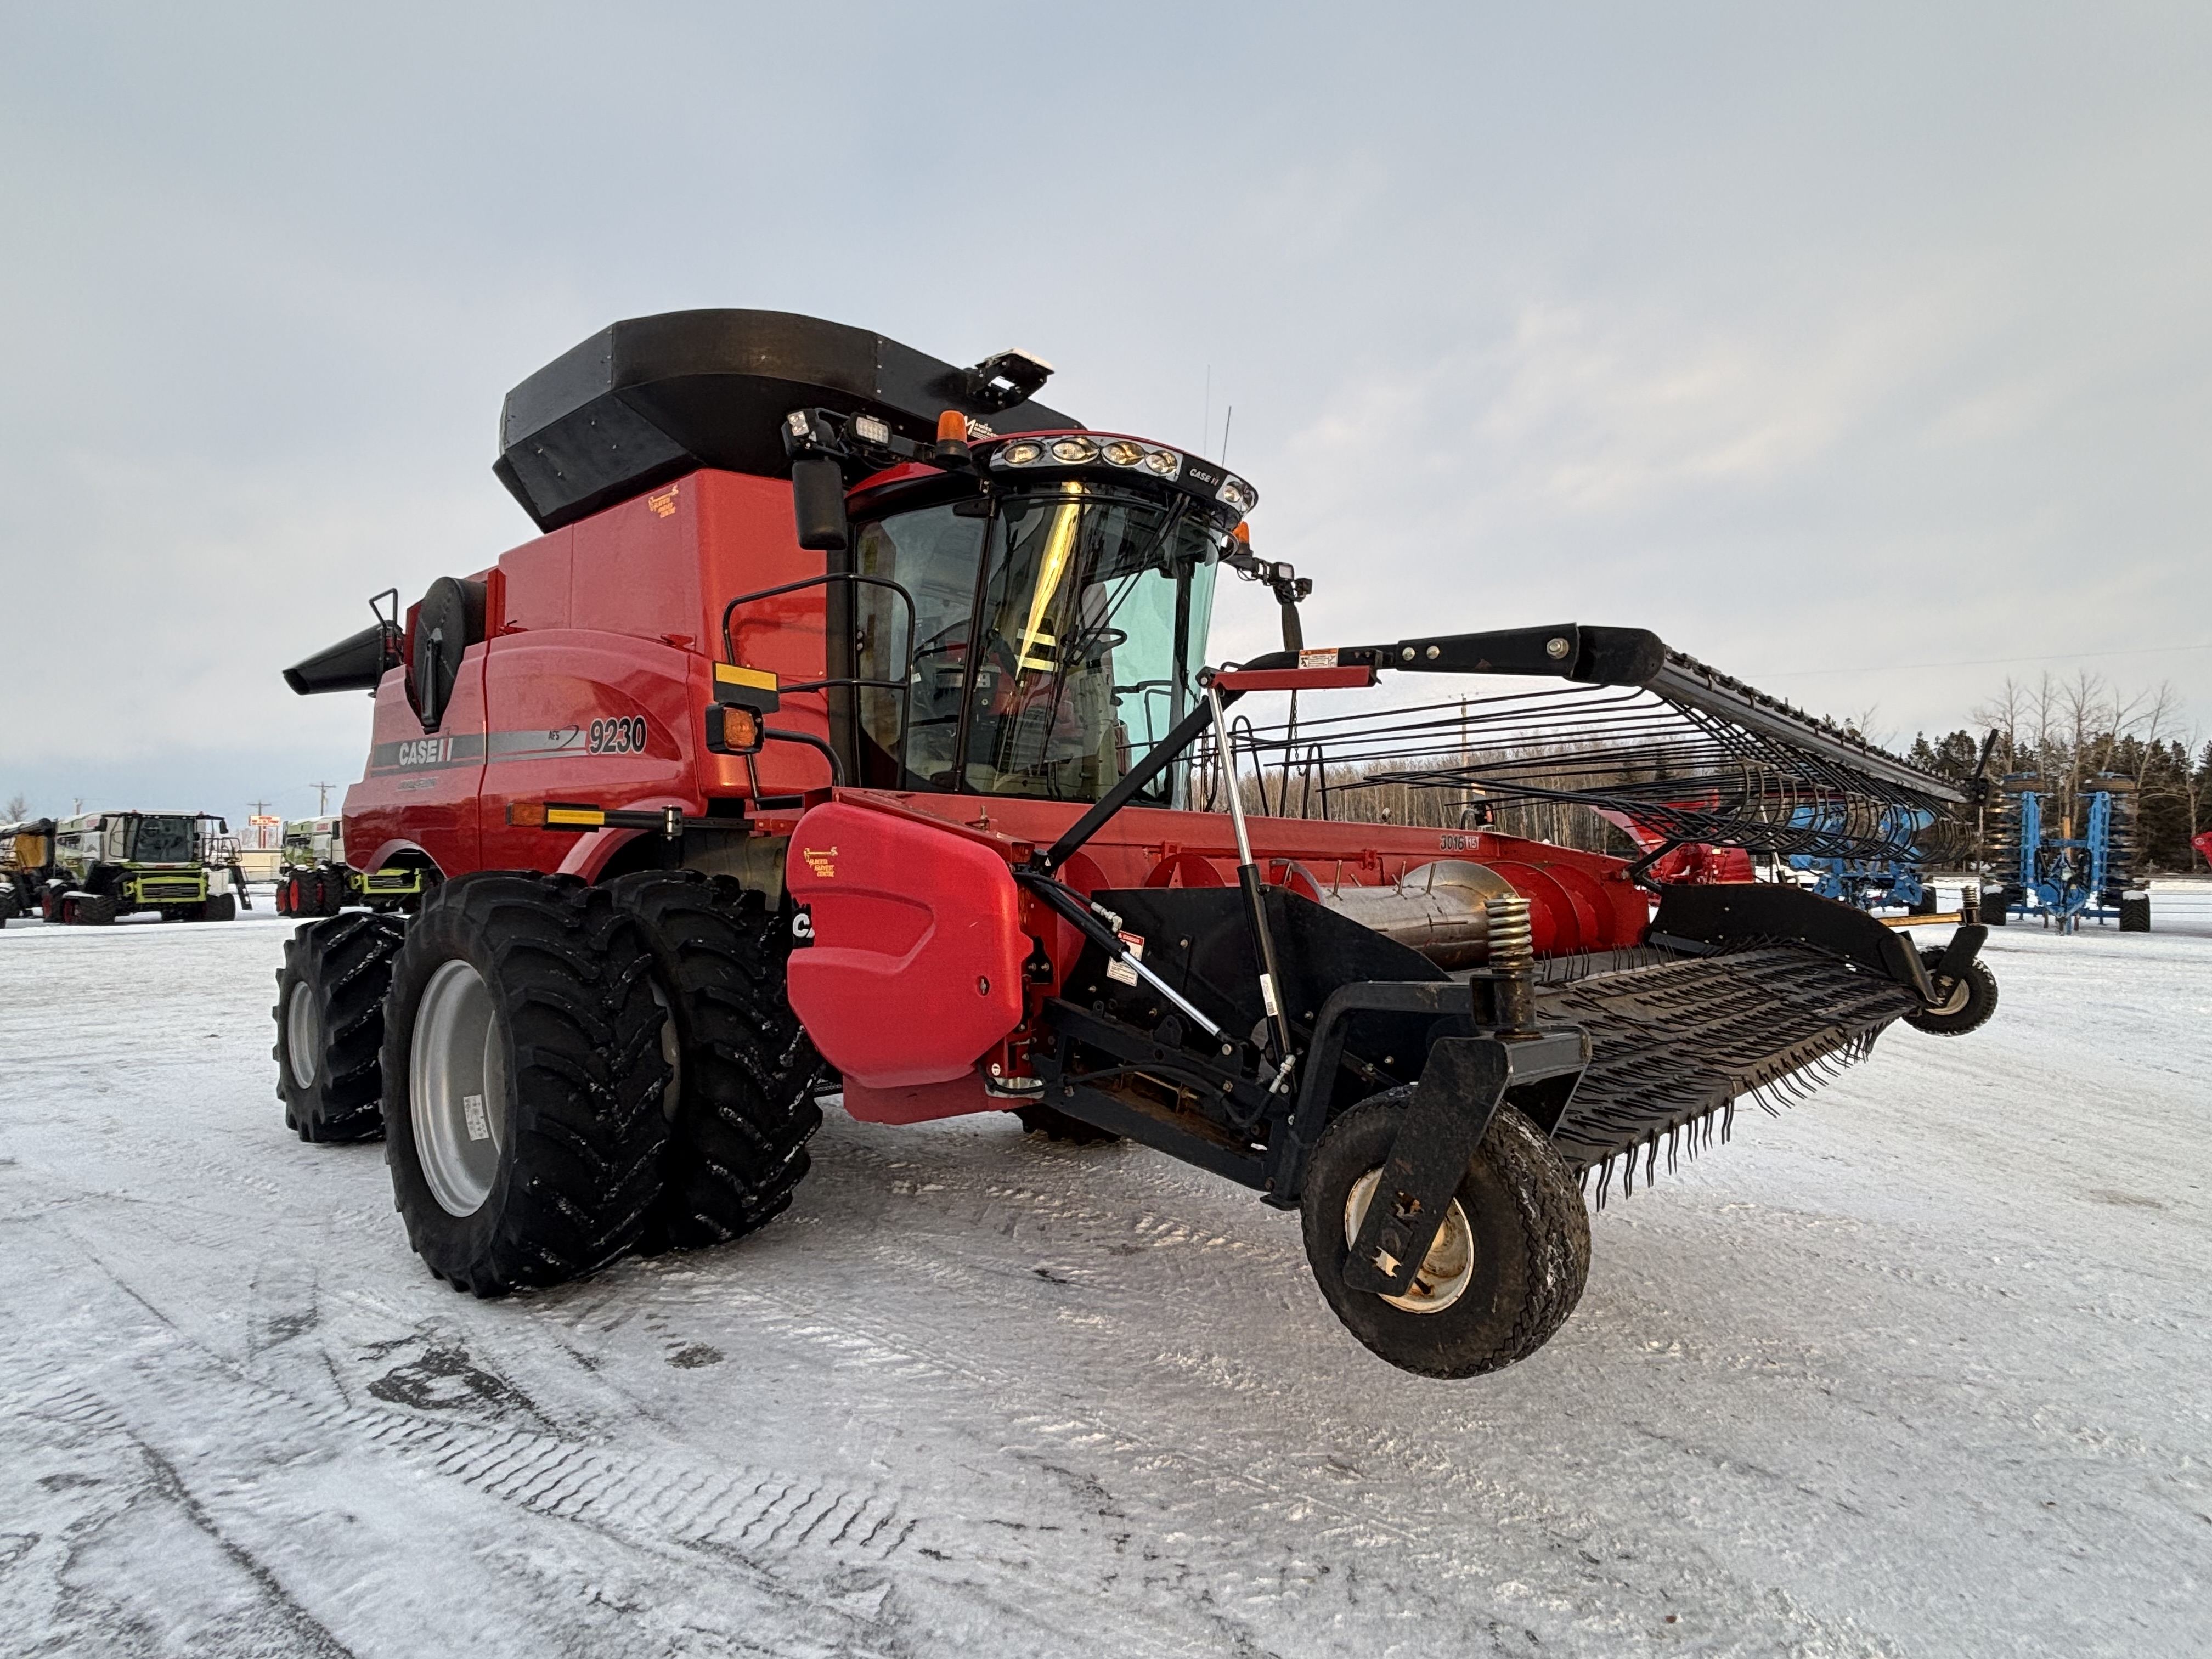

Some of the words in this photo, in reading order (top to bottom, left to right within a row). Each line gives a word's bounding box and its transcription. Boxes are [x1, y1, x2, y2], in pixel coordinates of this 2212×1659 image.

[1189, 469, 1211, 483] CASE
[548, 730, 560, 741] AFS
[589, 715, 647, 754] 9230
[399, 740, 438, 766] CASE
[1440, 834, 1465, 851] 3016
